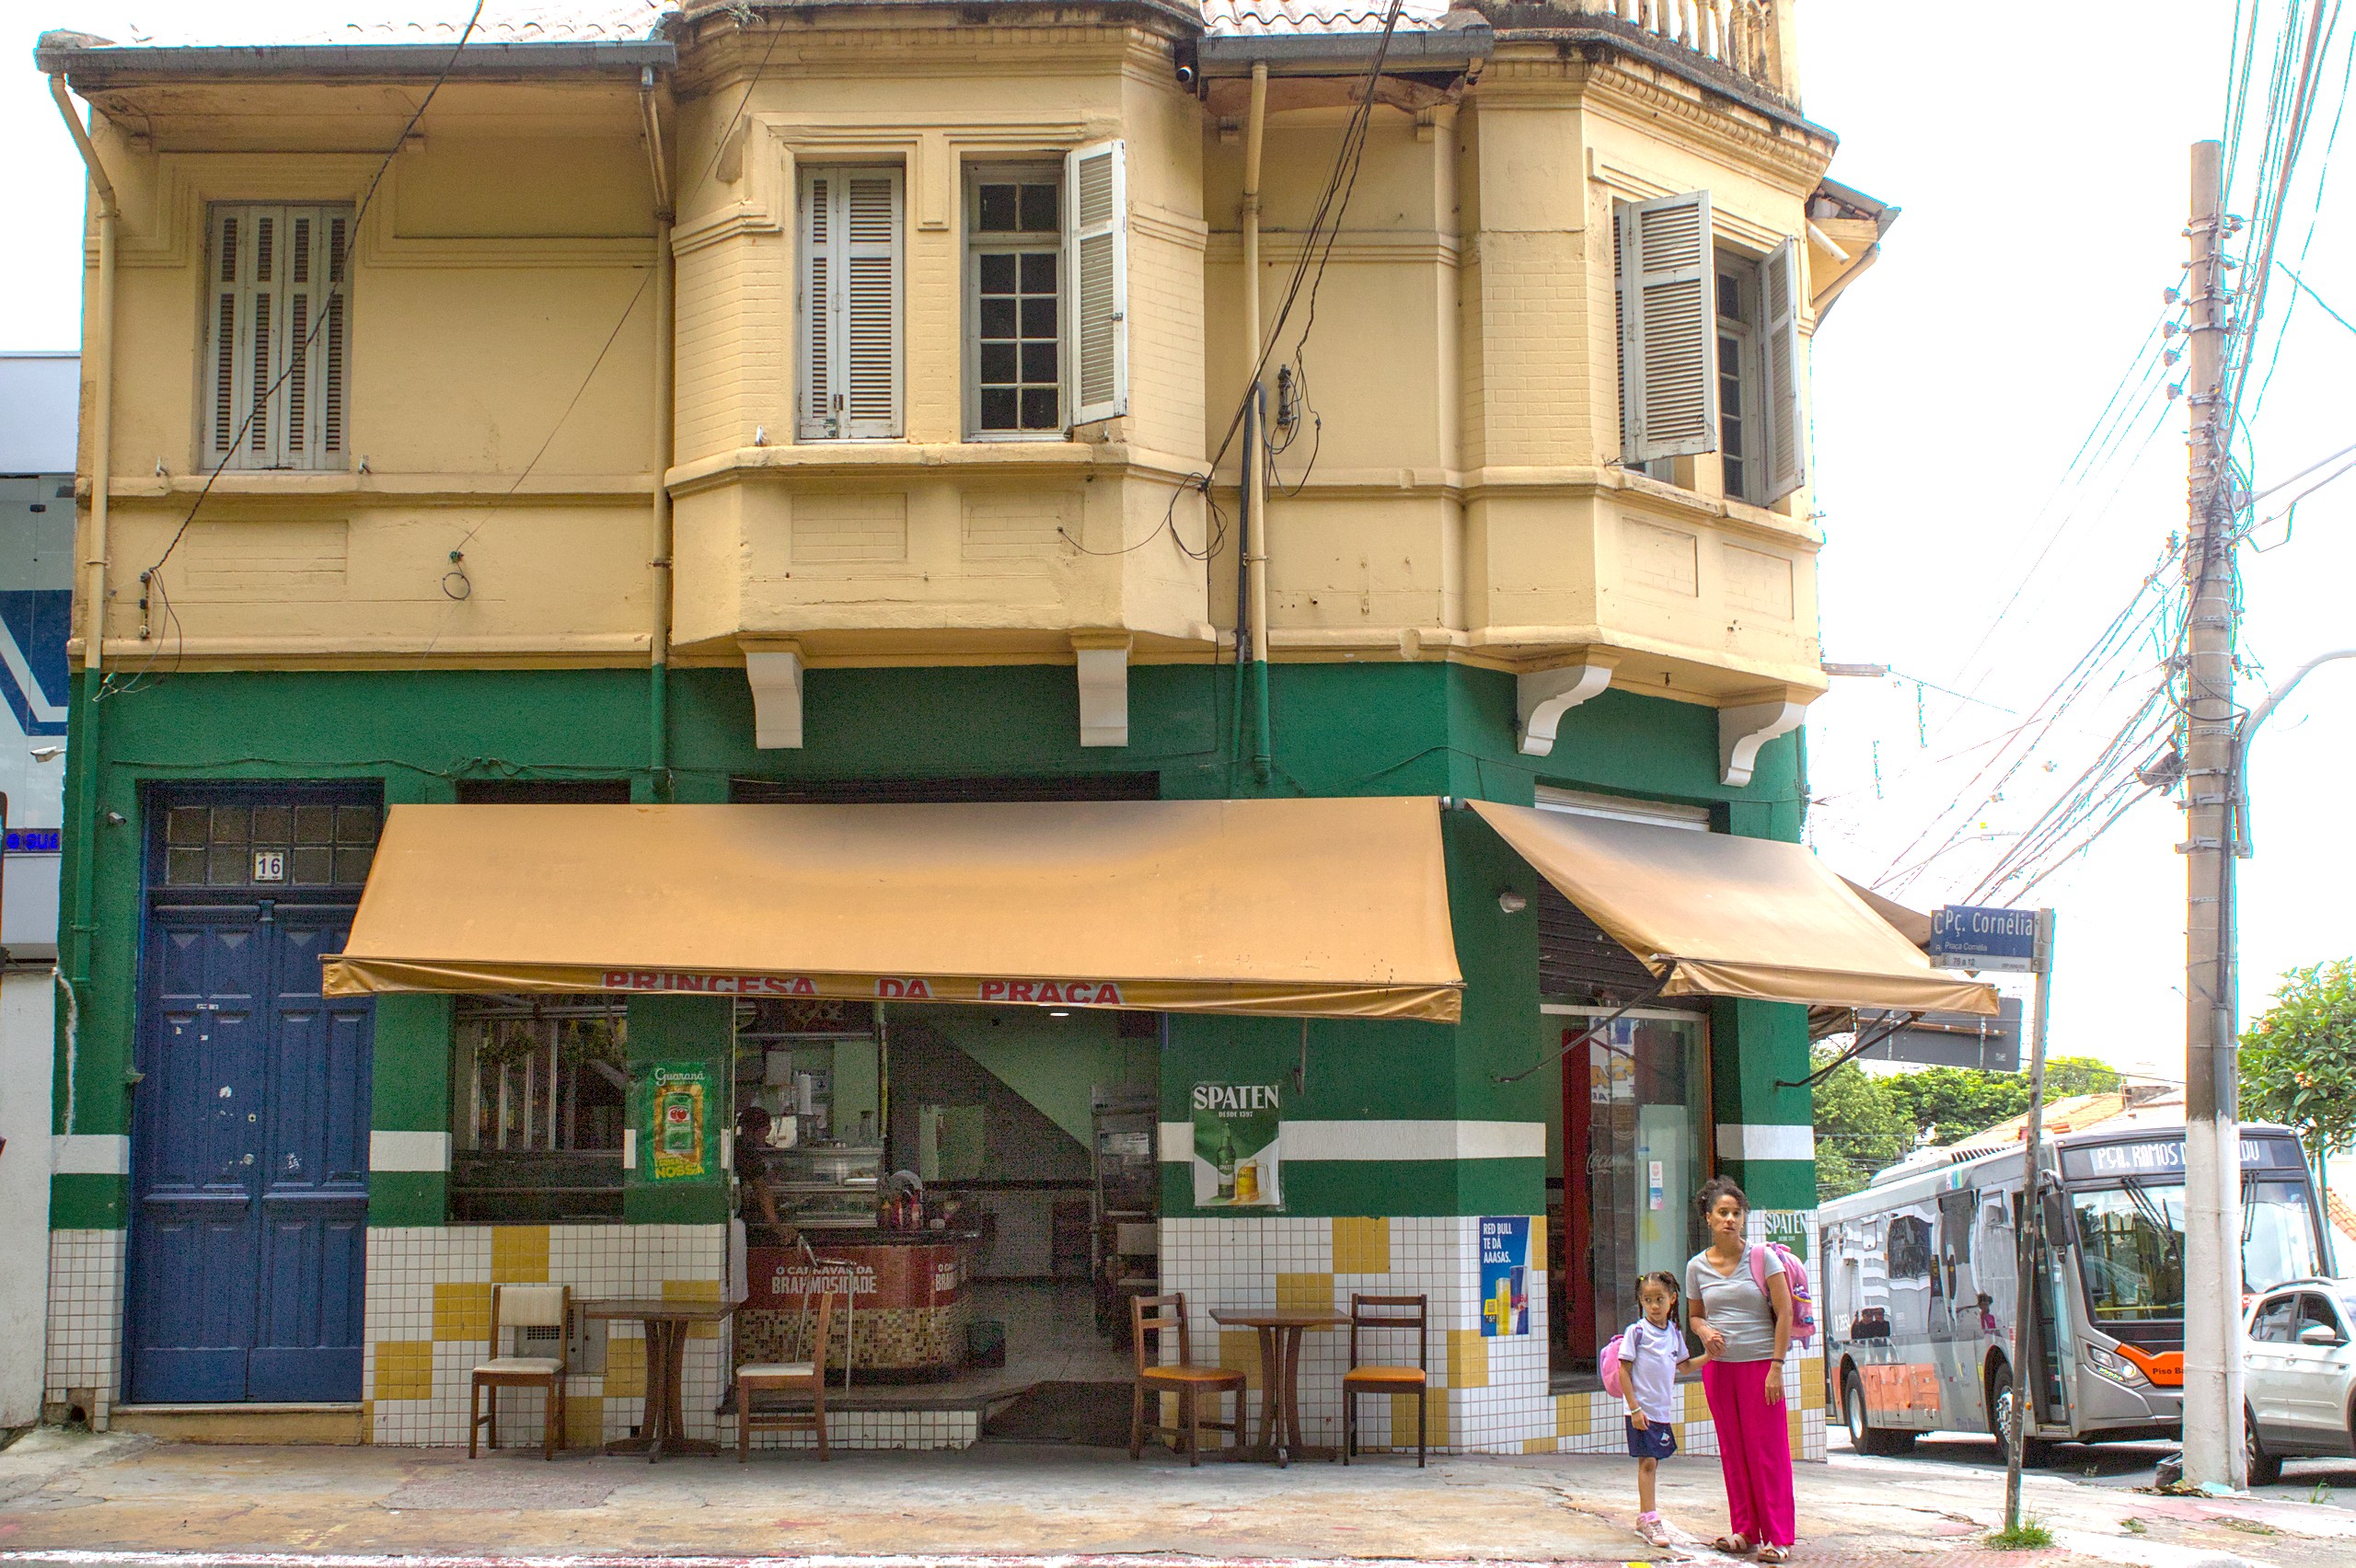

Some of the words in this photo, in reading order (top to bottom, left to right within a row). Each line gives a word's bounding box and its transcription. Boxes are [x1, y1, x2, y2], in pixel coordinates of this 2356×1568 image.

[259, 857, 281, 875] 16
[1945, 909, 1966, 937] Pç.
[1972, 911, 2033, 936] Cornélia
[605, 971, 816, 995] PRINCESA
[878, 978, 930, 998] DA
[654, 1067, 706, 1086] Guaraná
[1193, 1085, 1278, 1110] SPATEN
[2131, 1142, 2178, 1168] RAMOS
[655, 1163, 705, 1179] NOSSA
[1483, 1223, 1496, 1235] RED
[1497, 1222, 1512, 1234] BULL
[1765, 1213, 1807, 1235] SPATEN
[1483, 1238, 1491, 1250] TE
[1492, 1235, 1502, 1250] DÁ
[1484, 1251, 1511, 1263] AAASAS.
[857, 1265, 873, 1274] DA
